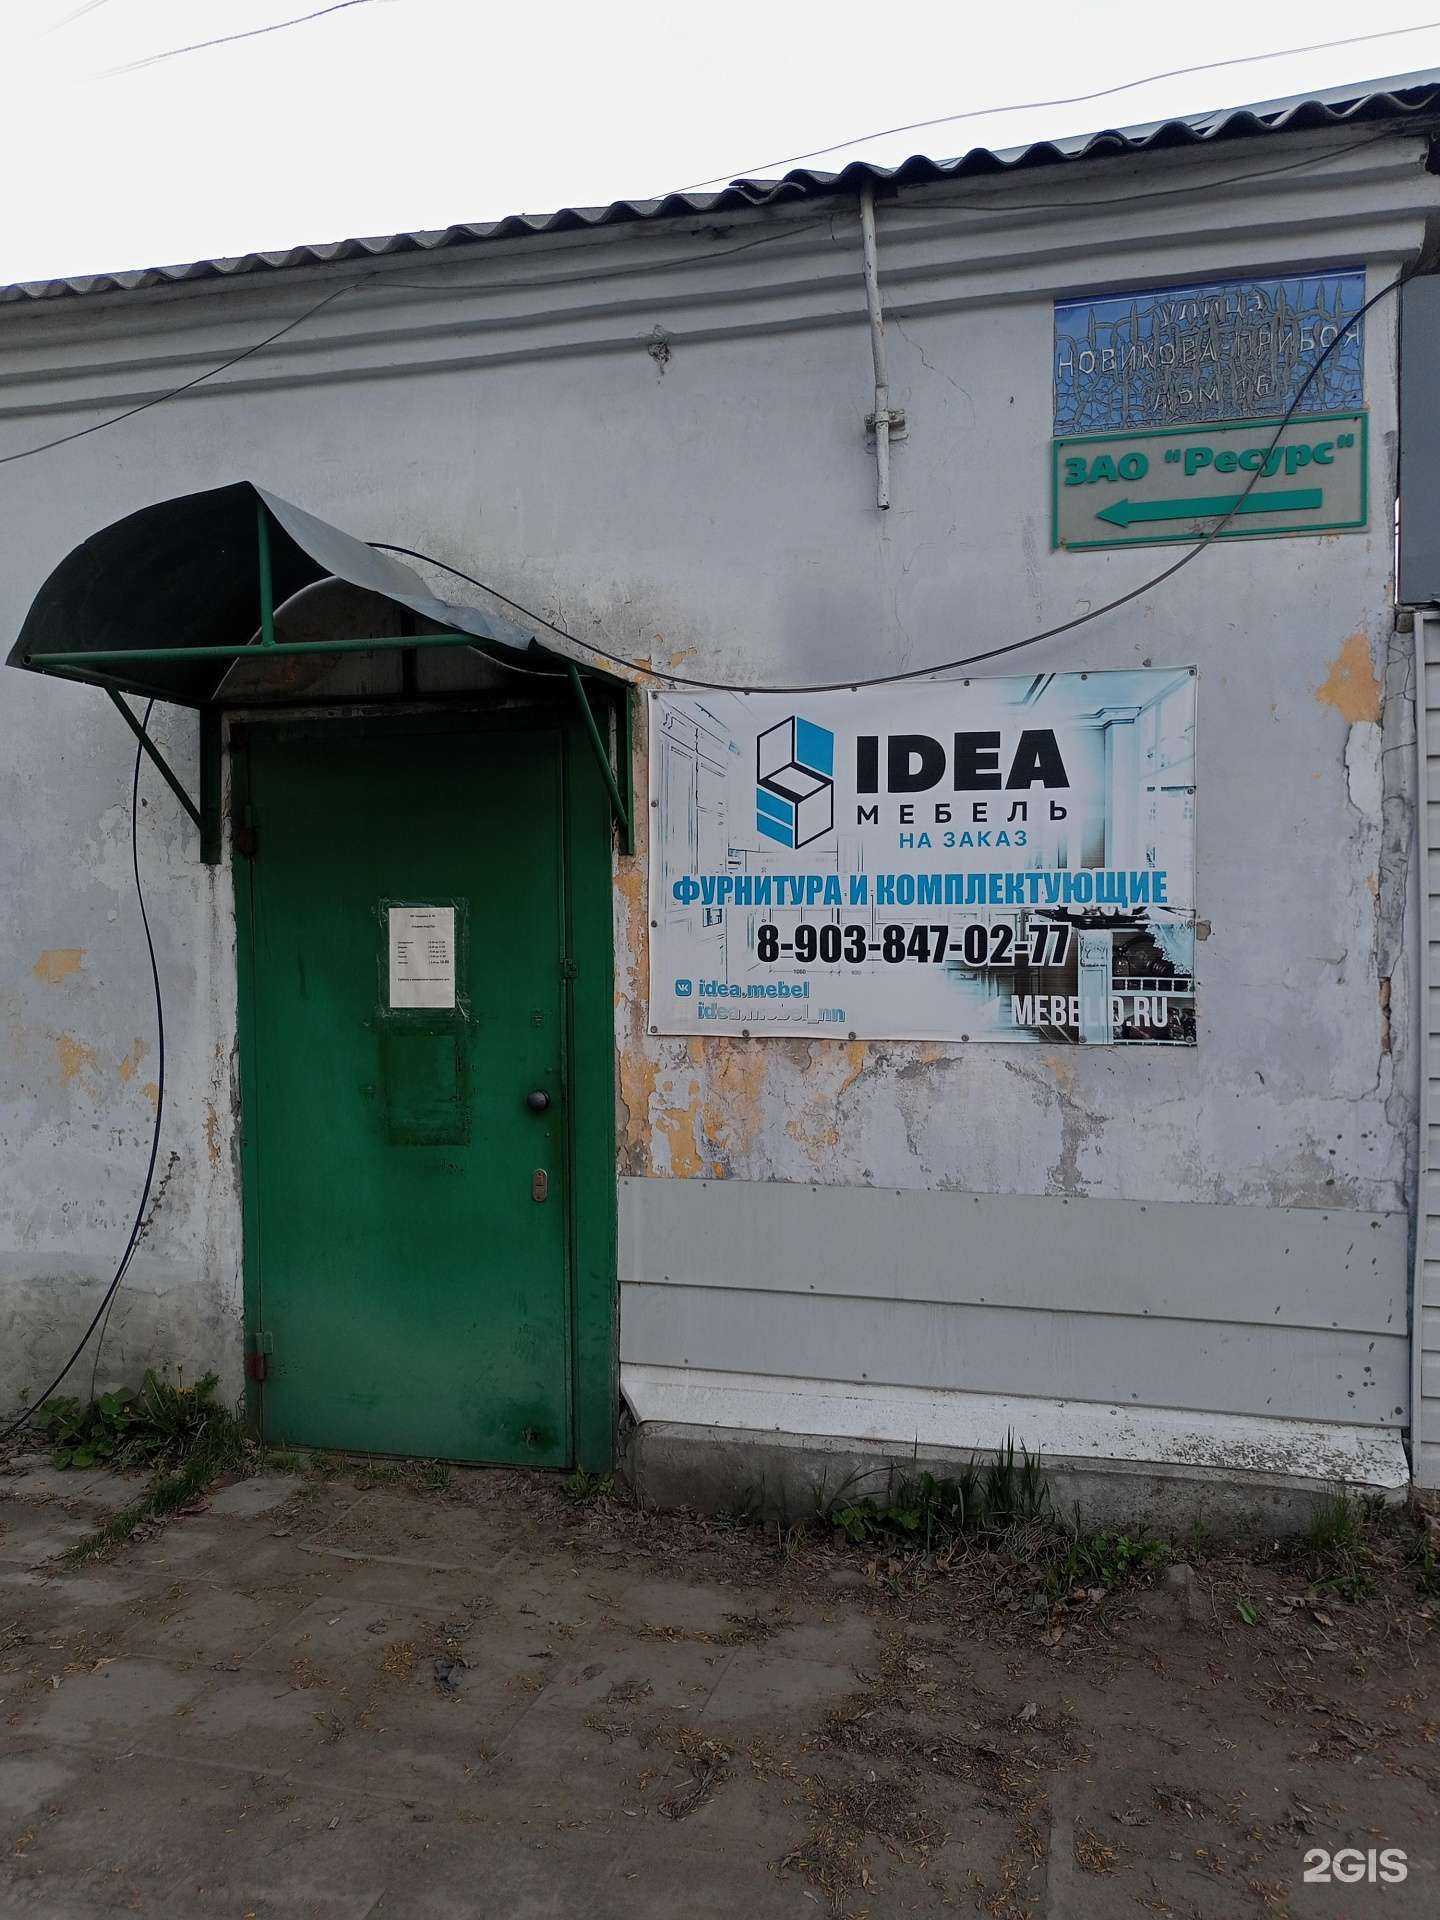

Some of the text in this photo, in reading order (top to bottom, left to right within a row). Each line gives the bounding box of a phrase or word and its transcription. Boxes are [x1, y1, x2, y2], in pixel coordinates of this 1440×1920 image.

[1064, 451, 1150, 485] ЗАО
[856, 728, 1070, 794] IDEA
[856, 801, 1068, 826] МЕБЕЛЬ
[899, 830, 1028, 849] НА ЗАКАЗ
[673, 871, 1168, 909] ФУРНИТУРА И КОМПЛЕКТУЮЩИЕ
[757, 923, 1071, 967] 8-903-847-02-77
[698, 980, 810, 998] idea.mebel
